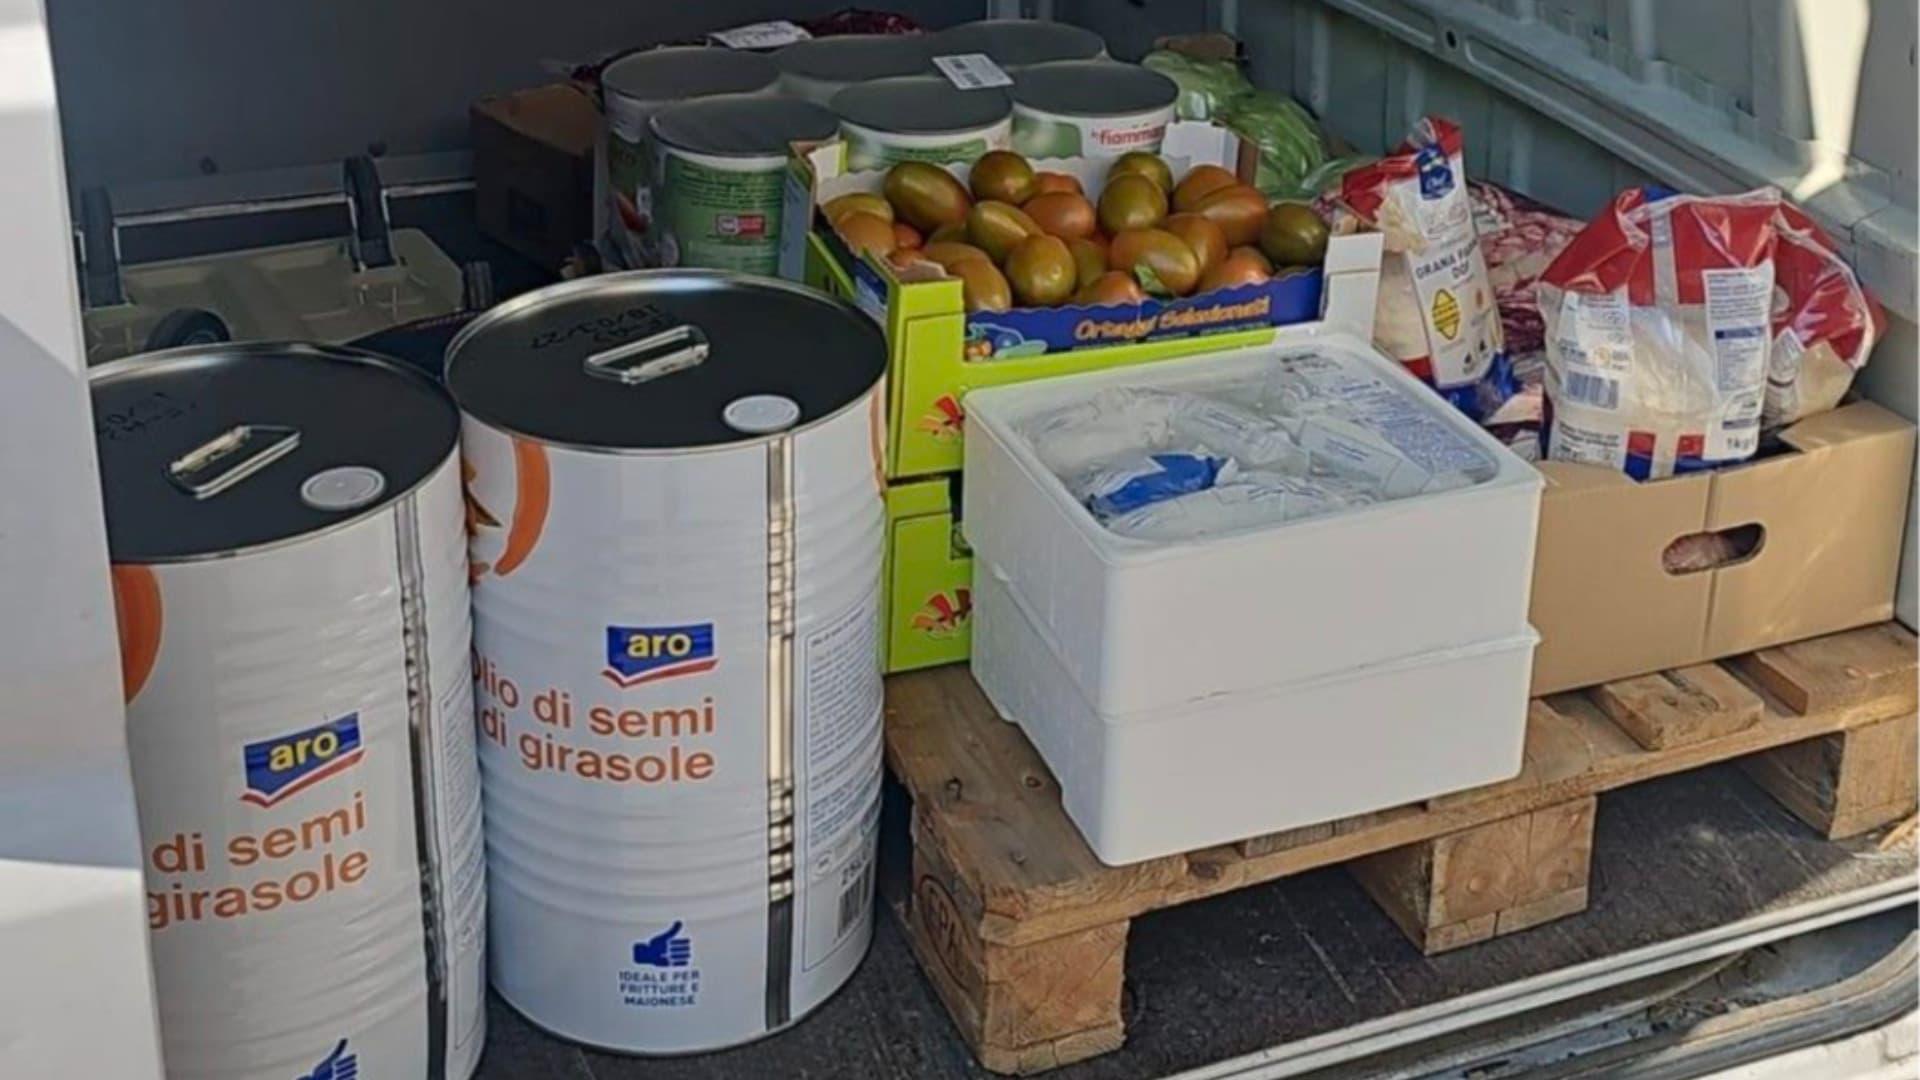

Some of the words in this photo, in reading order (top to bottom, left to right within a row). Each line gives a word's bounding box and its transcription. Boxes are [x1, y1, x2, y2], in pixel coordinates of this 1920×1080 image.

[627, 632, 692, 659] aro
[533, 689, 570, 729] di
[588, 697, 715, 738] semi
[269, 729, 341, 772] aro
[482, 706, 507, 748] di
[519, 733, 716, 783] girasole
[152, 832, 206, 874] di
[228, 790, 367, 867] semi
[146, 850, 369, 931] girasole
[618, 970, 668, 983] IDEALE
[672, 969, 700, 982] PER
[620, 983, 686, 995] FRITTURE
[691, 982, 700, 994] E
[624, 995, 696, 1007] MAIONESE
